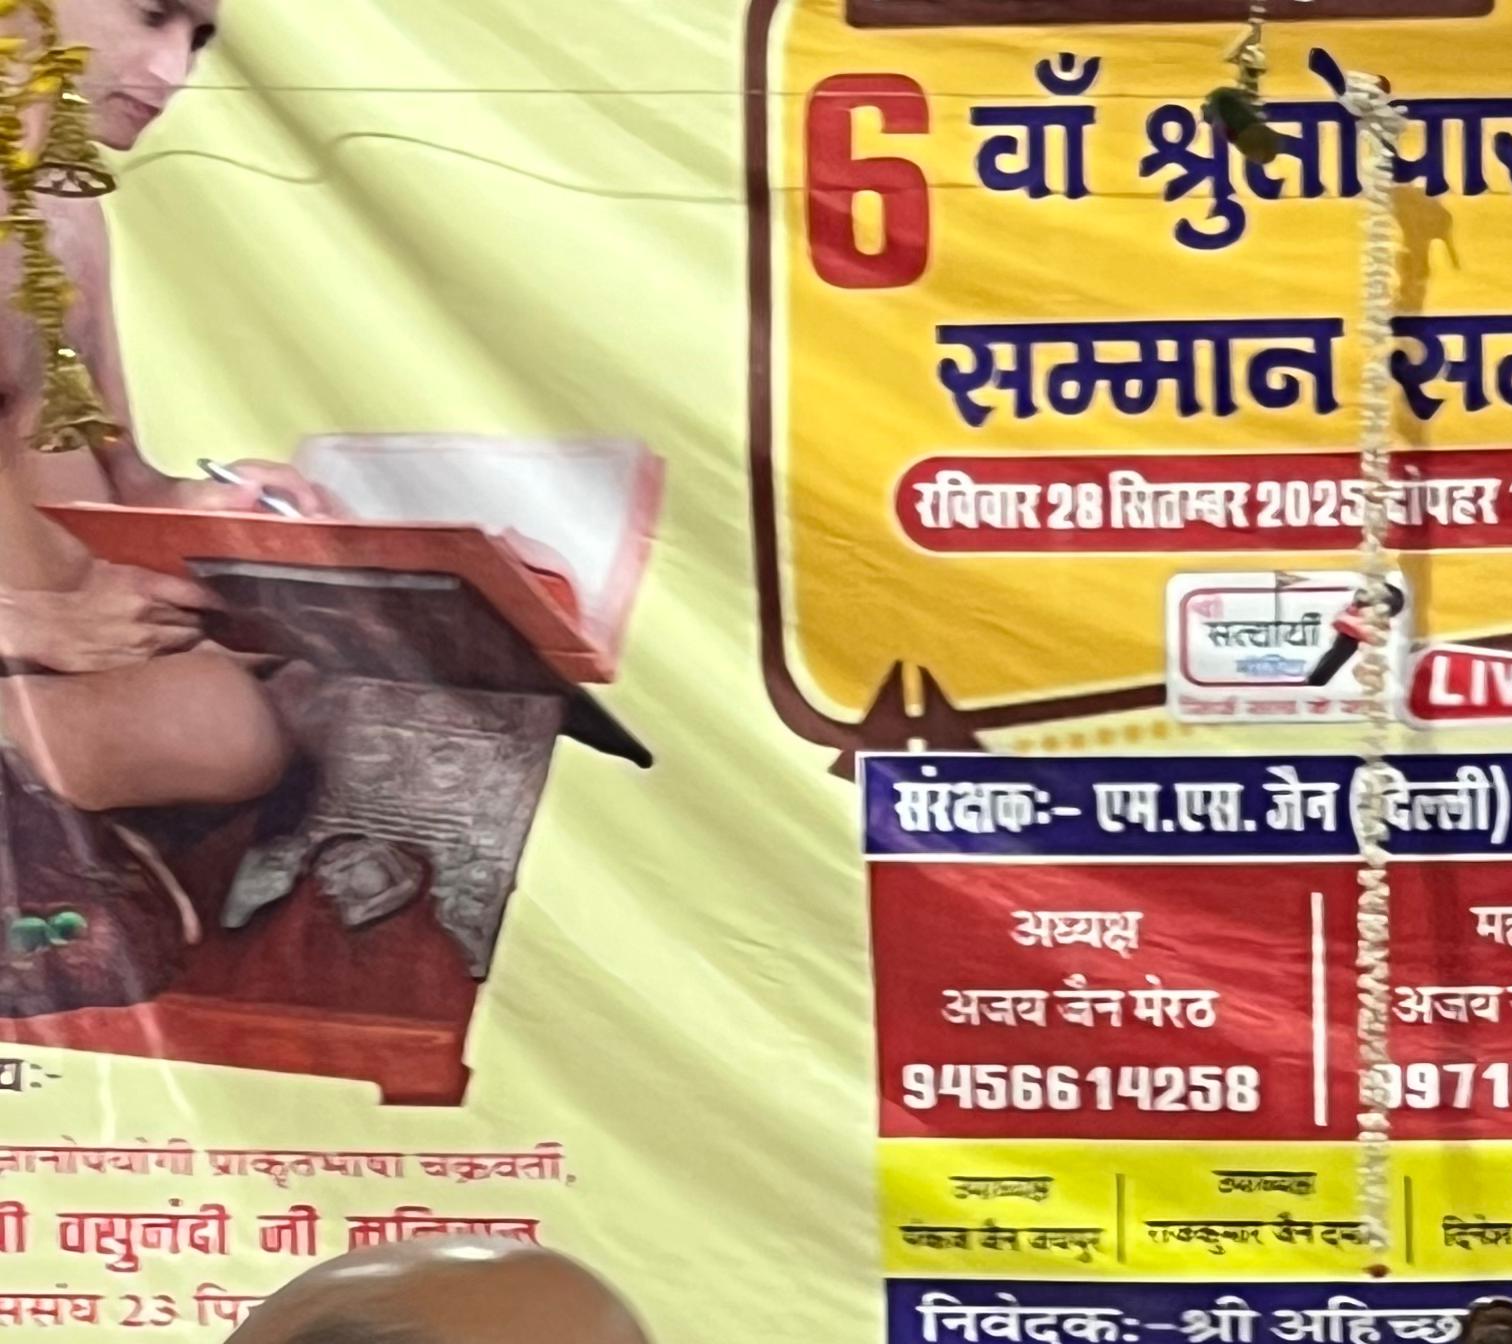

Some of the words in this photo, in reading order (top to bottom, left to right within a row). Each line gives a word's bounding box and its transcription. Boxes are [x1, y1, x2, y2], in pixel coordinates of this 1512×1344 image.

[805, 73, 929, 289] 6
[970, 52, 1100, 199] वाँ
[936, 317, 1344, 428] सम्मान
[912, 470, 1042, 529] रविवार
[1046, 482, 1102, 529] 28
[1109, 470, 1251, 529] सितम्बर
[1256, 478, 1369, 528] 2025
[1262, 765, 1340, 832] जैन
[1128, 974, 1220, 1028] मेरठ
[1391, 985, 1502, 1024] अजय
[902, 1064, 1261, 1112] 9456614258
[257, 1205, 319, 1255] जी
[119, 1294, 180, 1327] 23
[1178, 1294, 1262, 1343] श्री
